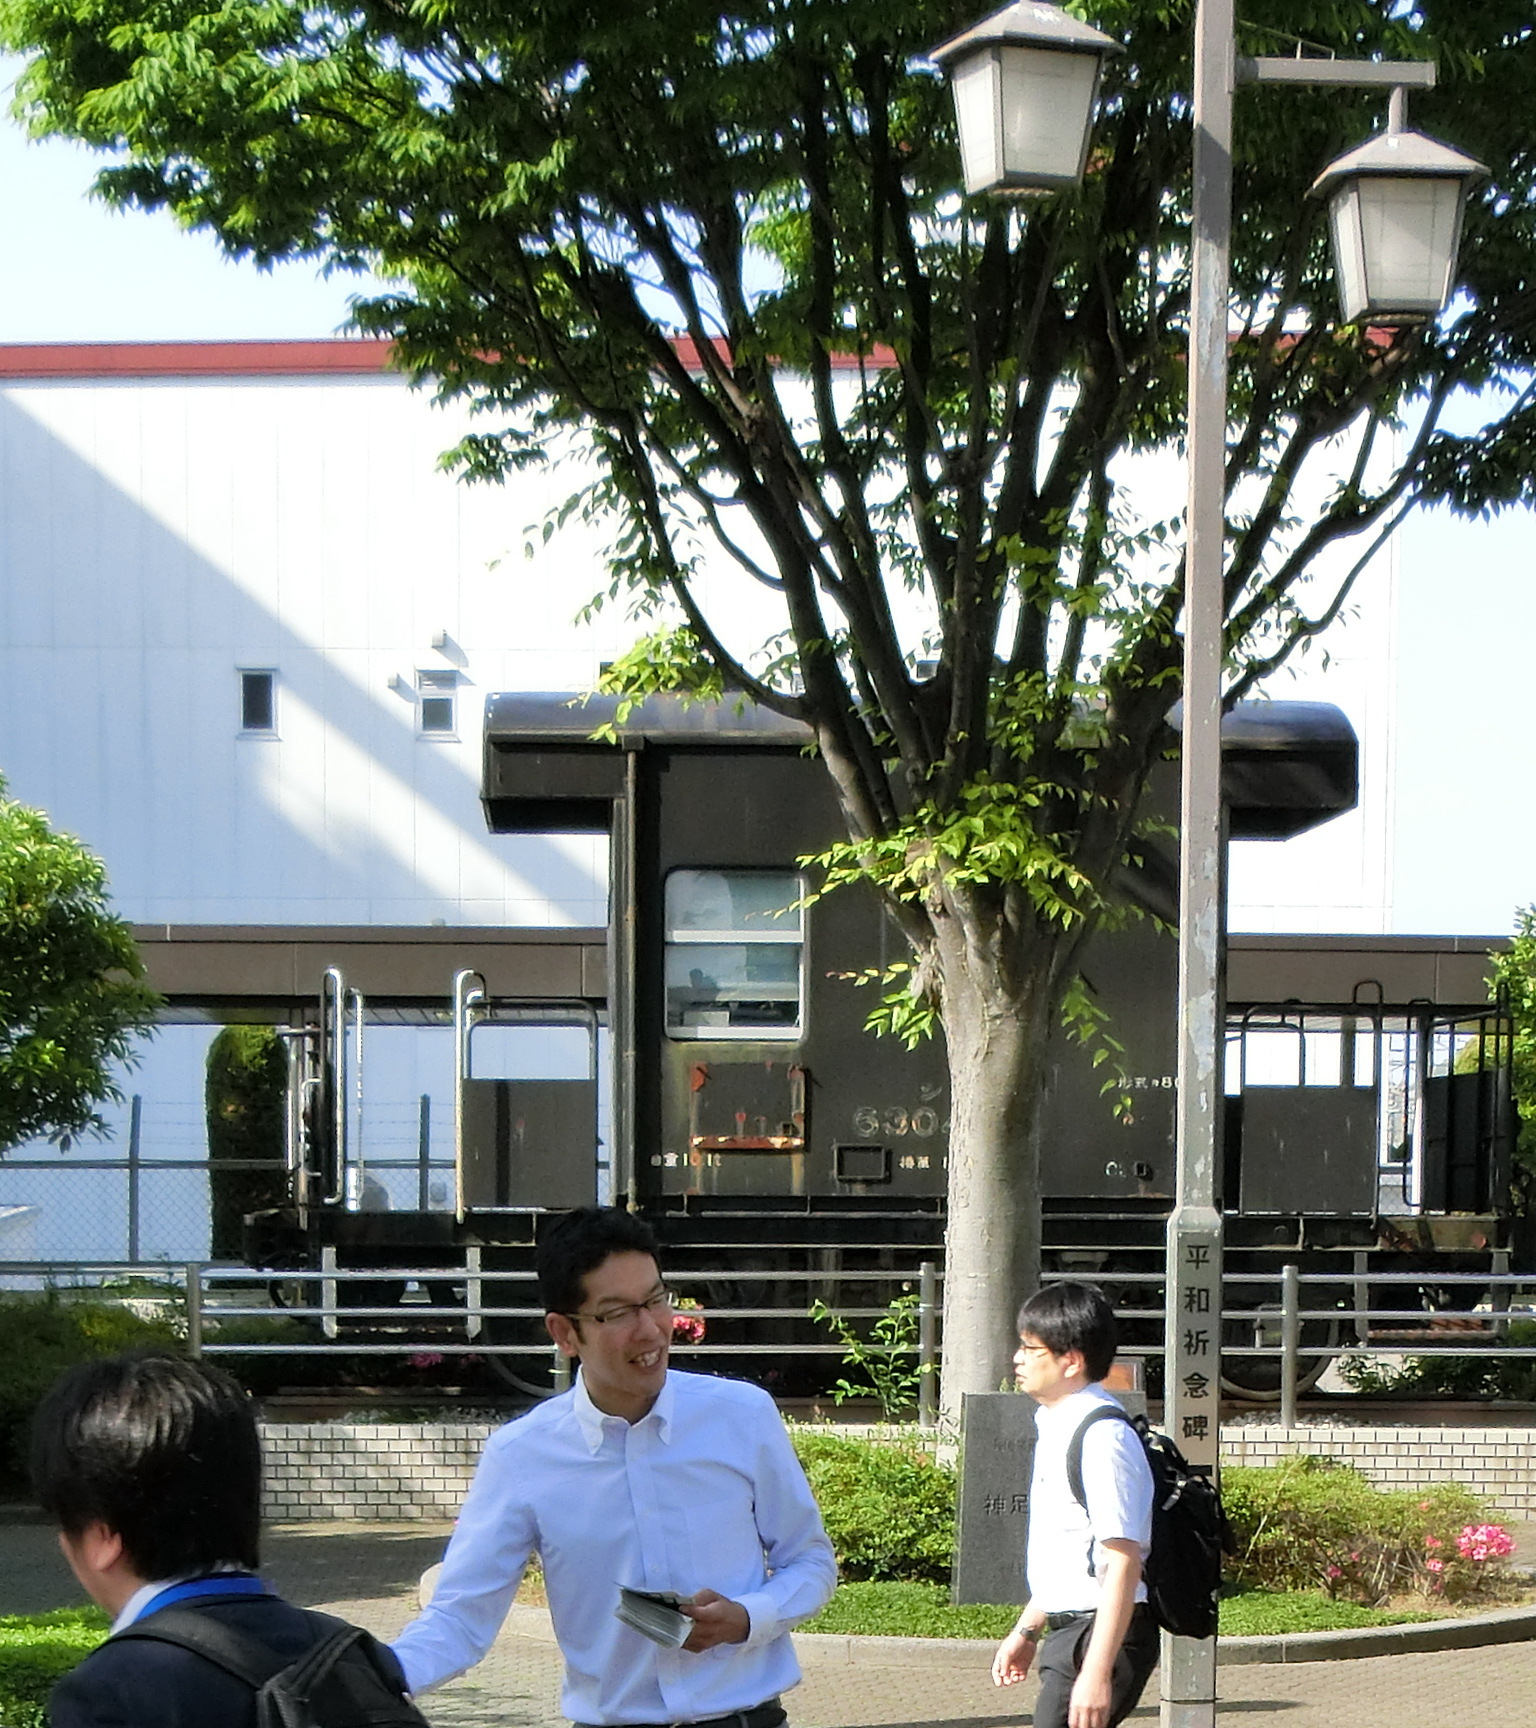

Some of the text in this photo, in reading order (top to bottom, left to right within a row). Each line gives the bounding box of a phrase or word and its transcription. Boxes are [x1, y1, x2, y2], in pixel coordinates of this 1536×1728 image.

[1182, 1243, 1211, 1442] 平和祈念碑
